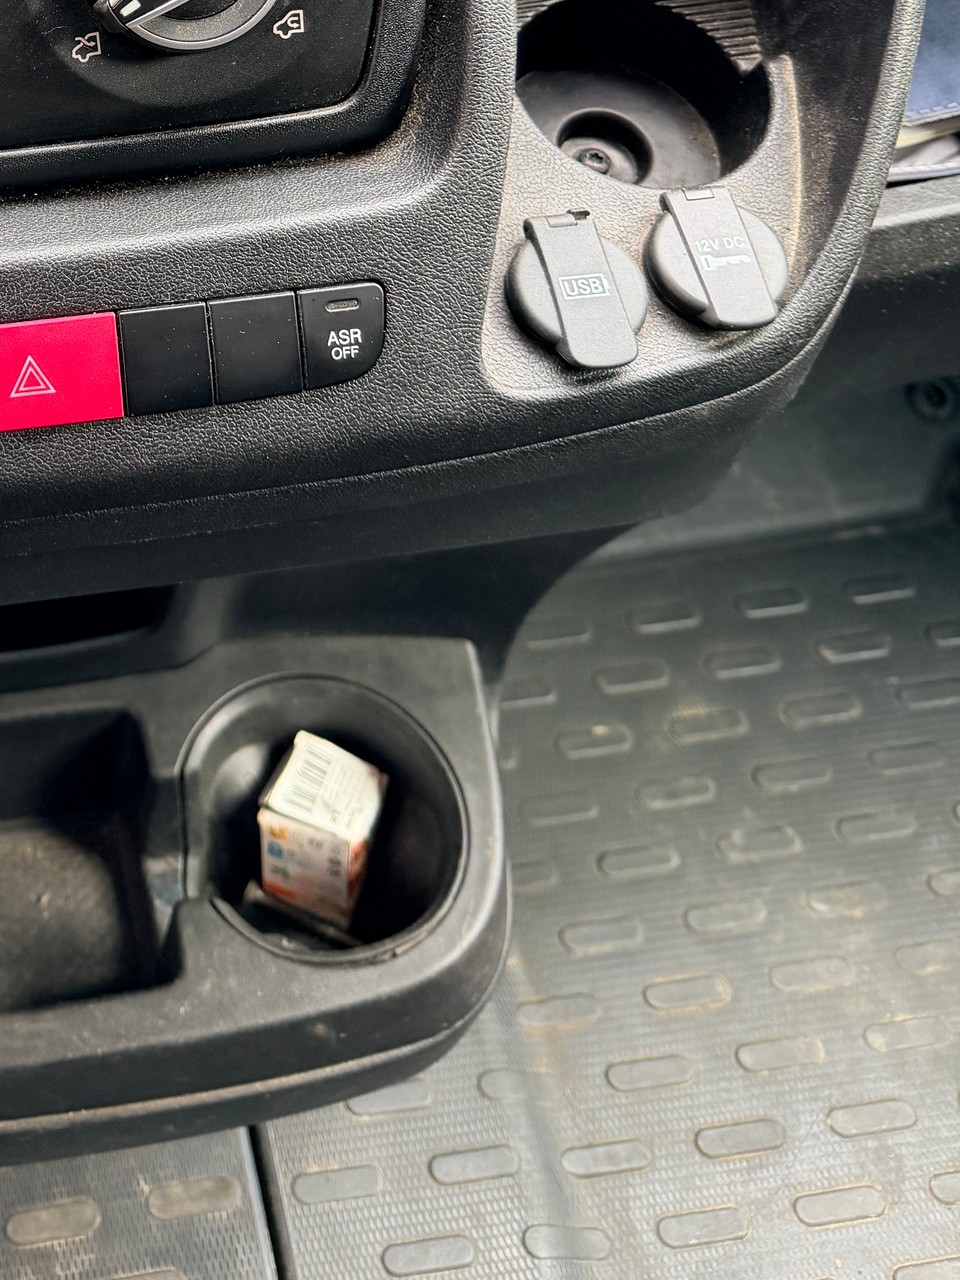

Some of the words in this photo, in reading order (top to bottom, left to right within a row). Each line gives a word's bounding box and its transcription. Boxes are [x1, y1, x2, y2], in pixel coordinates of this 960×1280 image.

[694, 238, 719, 252] 12V
[721, 236, 745, 249] DC
[563, 278, 605, 296] USB
[327, 328, 362, 346] ASR
[331, 345, 360, 360] OFF
